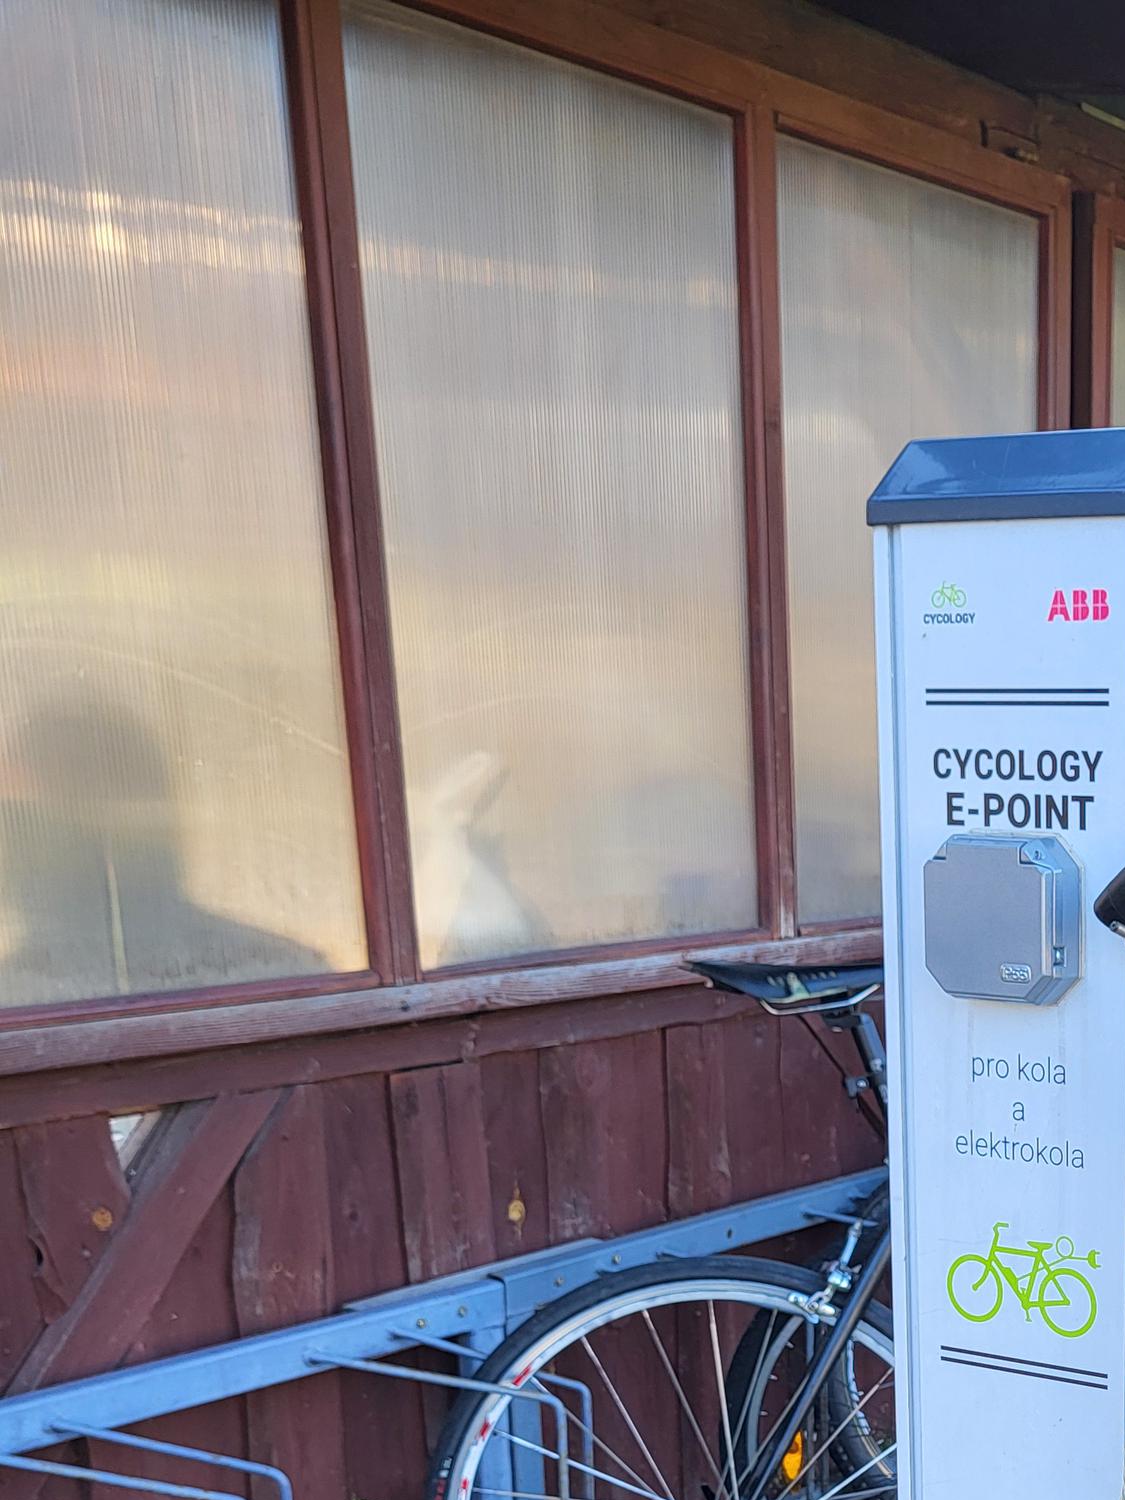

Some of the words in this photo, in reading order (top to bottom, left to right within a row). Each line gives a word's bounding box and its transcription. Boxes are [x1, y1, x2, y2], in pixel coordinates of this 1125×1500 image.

[923, 612, 975, 625] CYCOLOGY
[1047, 589, 1110, 622] ABB
[932, 748, 1104, 784] CYCOLOGY
[945, 792, 1095, 832] E-POINT
[970, 1054, 1010, 1085] pro
[1017, 1053, 1068, 1086] kola
[1011, 1101, 1026, 1122] a
[954, 1131, 1085, 1170] elektrokola
